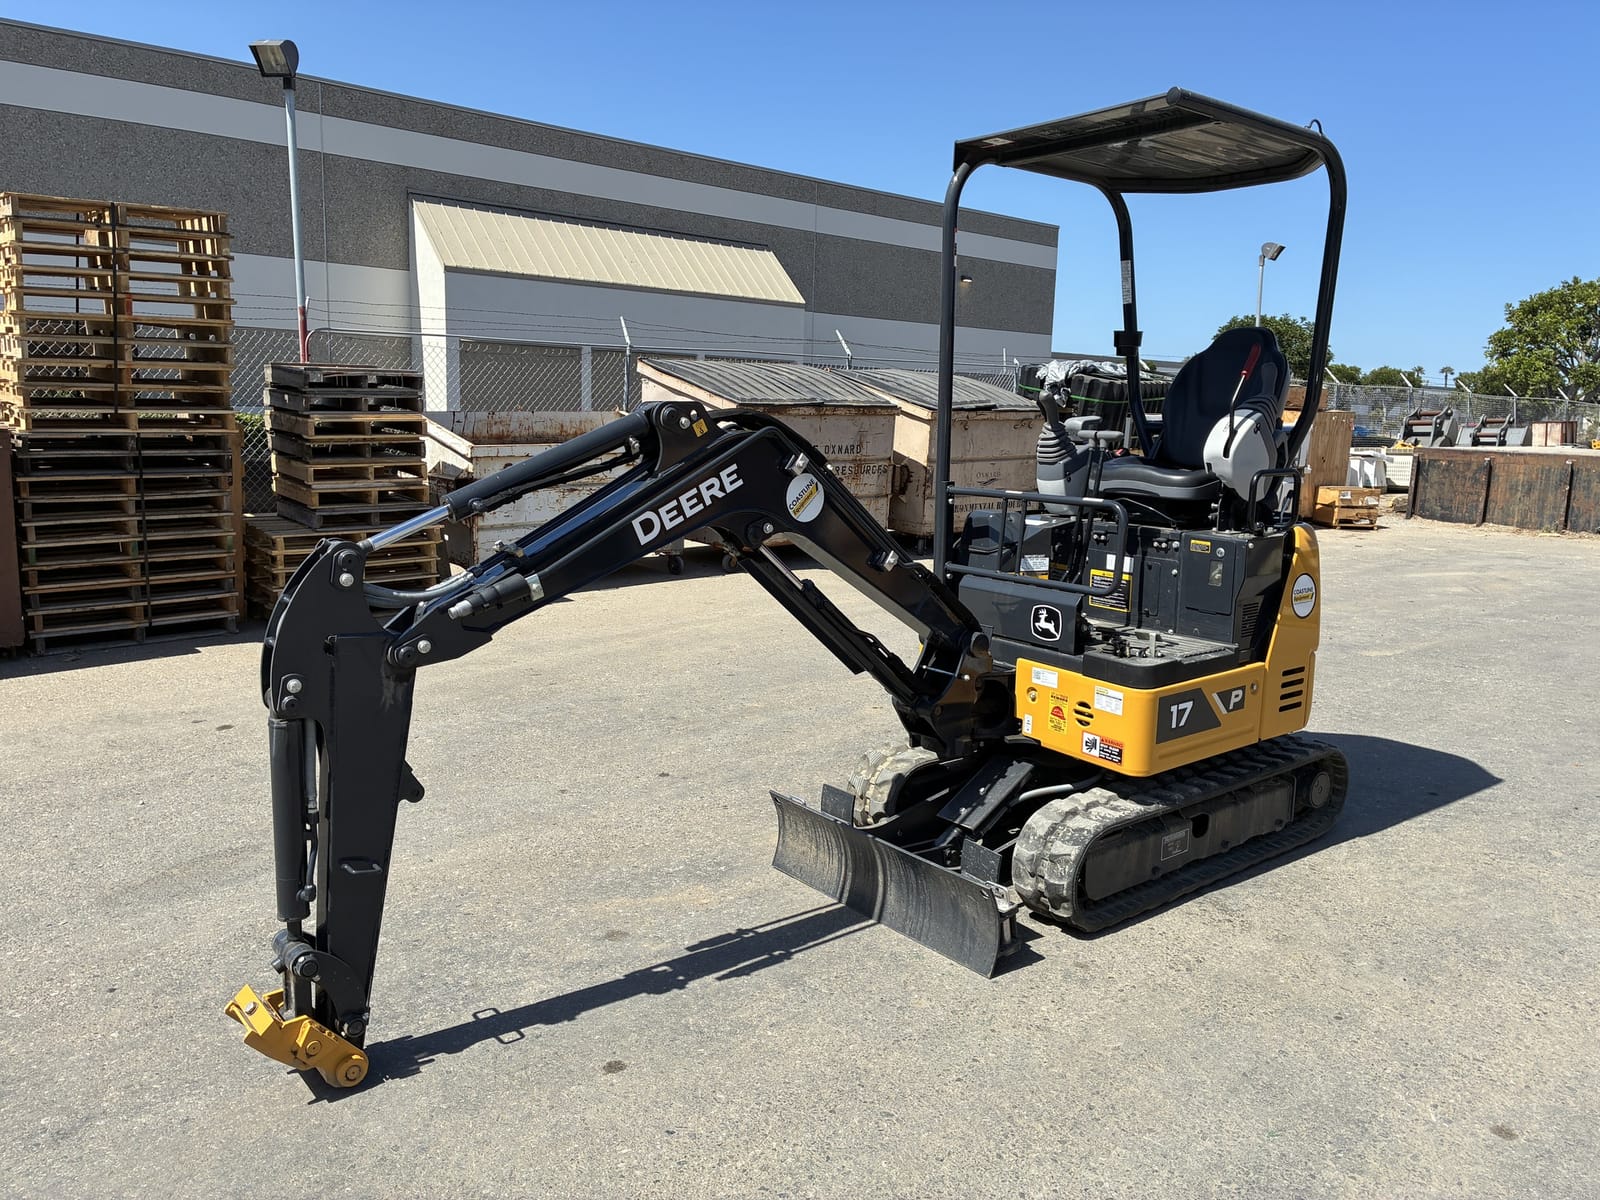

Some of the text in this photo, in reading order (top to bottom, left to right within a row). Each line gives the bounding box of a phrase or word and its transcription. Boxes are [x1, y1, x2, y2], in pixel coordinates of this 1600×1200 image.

[824, 444, 861, 454] OXNARD
[631, 463, 744, 546] DEERE
[789, 478, 815, 510] COASTLINE
[1170, 700, 1194, 729] 17
